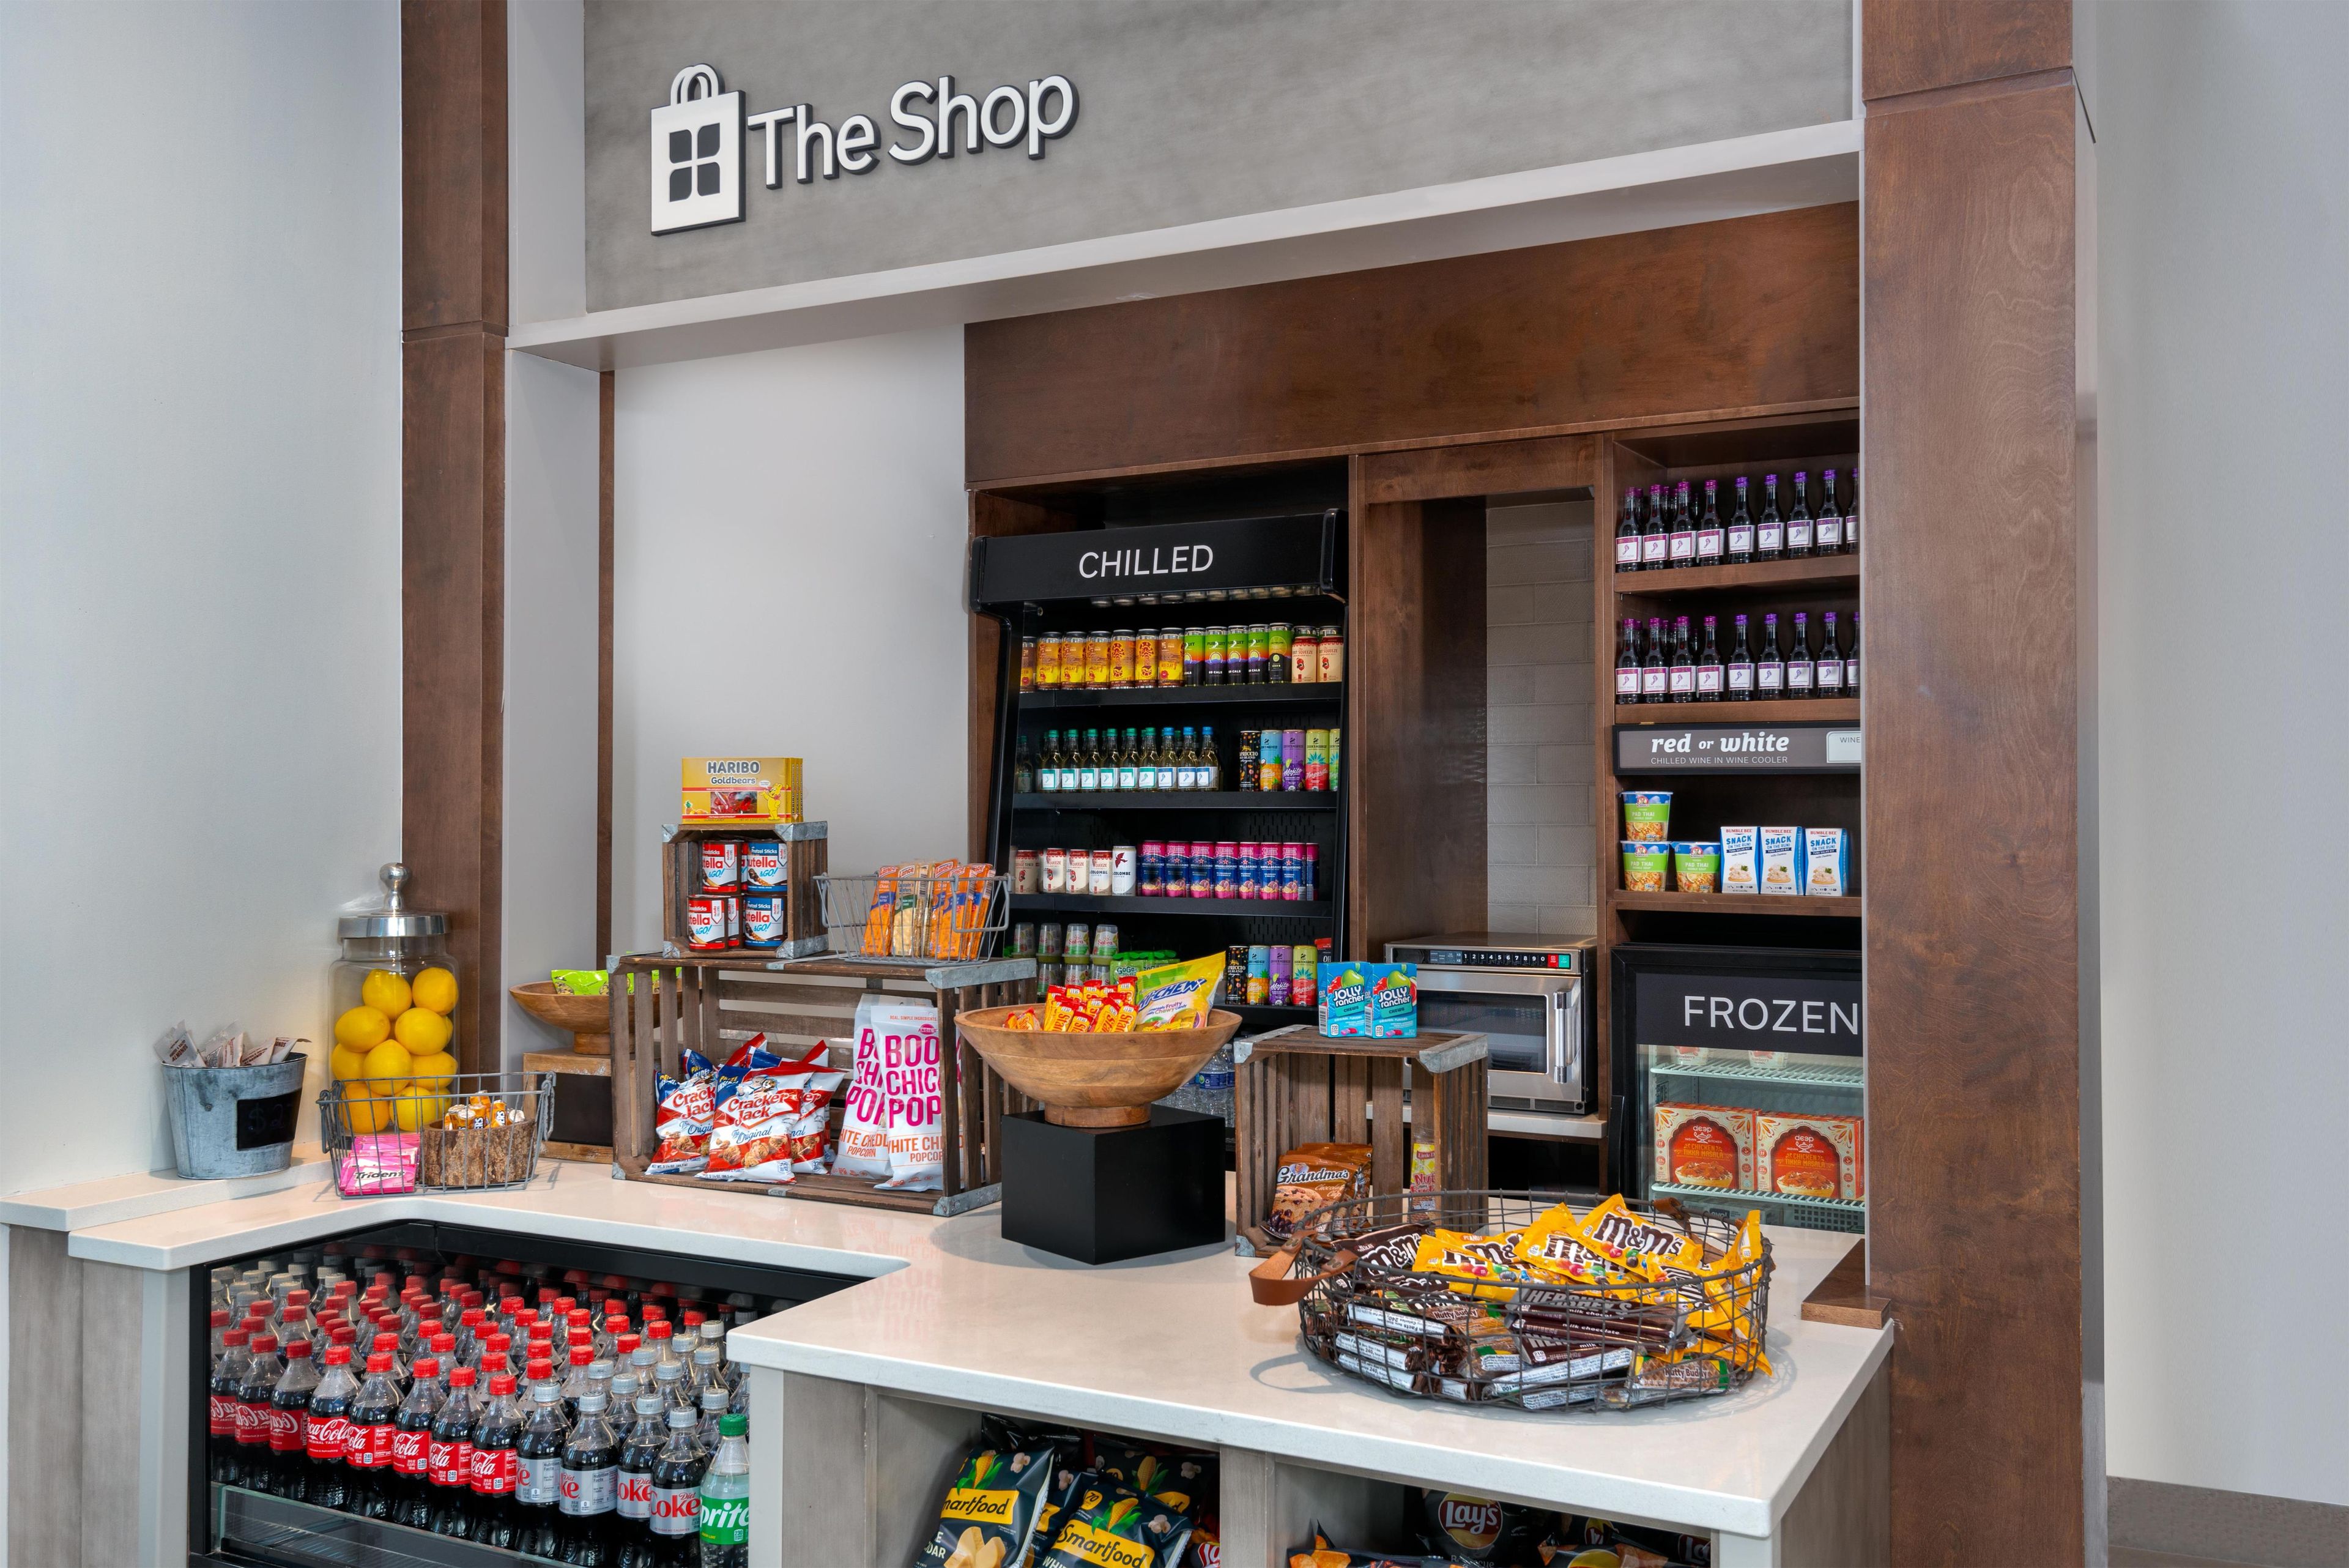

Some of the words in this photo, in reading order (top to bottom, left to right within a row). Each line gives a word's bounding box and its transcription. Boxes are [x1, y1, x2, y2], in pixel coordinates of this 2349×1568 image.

[748, 103, 880, 190] The
[889, 75, 1078, 160] Shop
[1079, 545, 1214, 578] CHILLED
[1651, 734, 1691, 753] red
[1699, 740, 1713, 749] or
[1720, 732, 1790, 752] white
[707, 761, 760, 774] HARIBO
[1283, 767, 1303, 776] Mojito
[1726, 835, 1752, 844] SNACK
[1765, 836, 1791, 845] SNACK
[1810, 838, 1836, 847] SNACK
[708, 868, 725, 877] &GO!
[759, 867, 779, 877] &GO!
[900, 866, 915, 877] Lance
[936, 863, 953, 875] Lance
[695, 924, 713, 934] &GO!
[753, 921, 771, 932] &GO!
[1270, 982, 1290, 991] Mojito
[1334, 986, 1362, 1001] JOLLY
[1379, 987, 1408, 1002] JOLLY
[1336, 994, 1365, 1006] rancher
[1381, 996, 1410, 1008] rancher
[1685, 995, 1858, 1035] FROZEN
[886, 1068, 940, 1096] CHIC
[728, 1093, 790, 1111] Cracker
[735, 1107, 770, 1126] Jack
[736, 1126, 773, 1144] Original
[1795, 1134, 1814, 1143] deep
[847, 1146, 876, 1157] POPCORN
[355, 1170, 405, 1180] Trident
[1277, 1165, 1349, 1184] Grandma's
[1433, 1310, 1455, 1321] Nutty
[1581, 1325, 1620, 1335] chocolate
[563, 1473, 574, 1481] Diet
[1086, 1492, 1099, 1502] 70
[650, 1490, 700, 1518] Coke
[1445, 1498, 1498, 1535] Lay's
[1056, 1524, 1147, 1568] Smartfood
